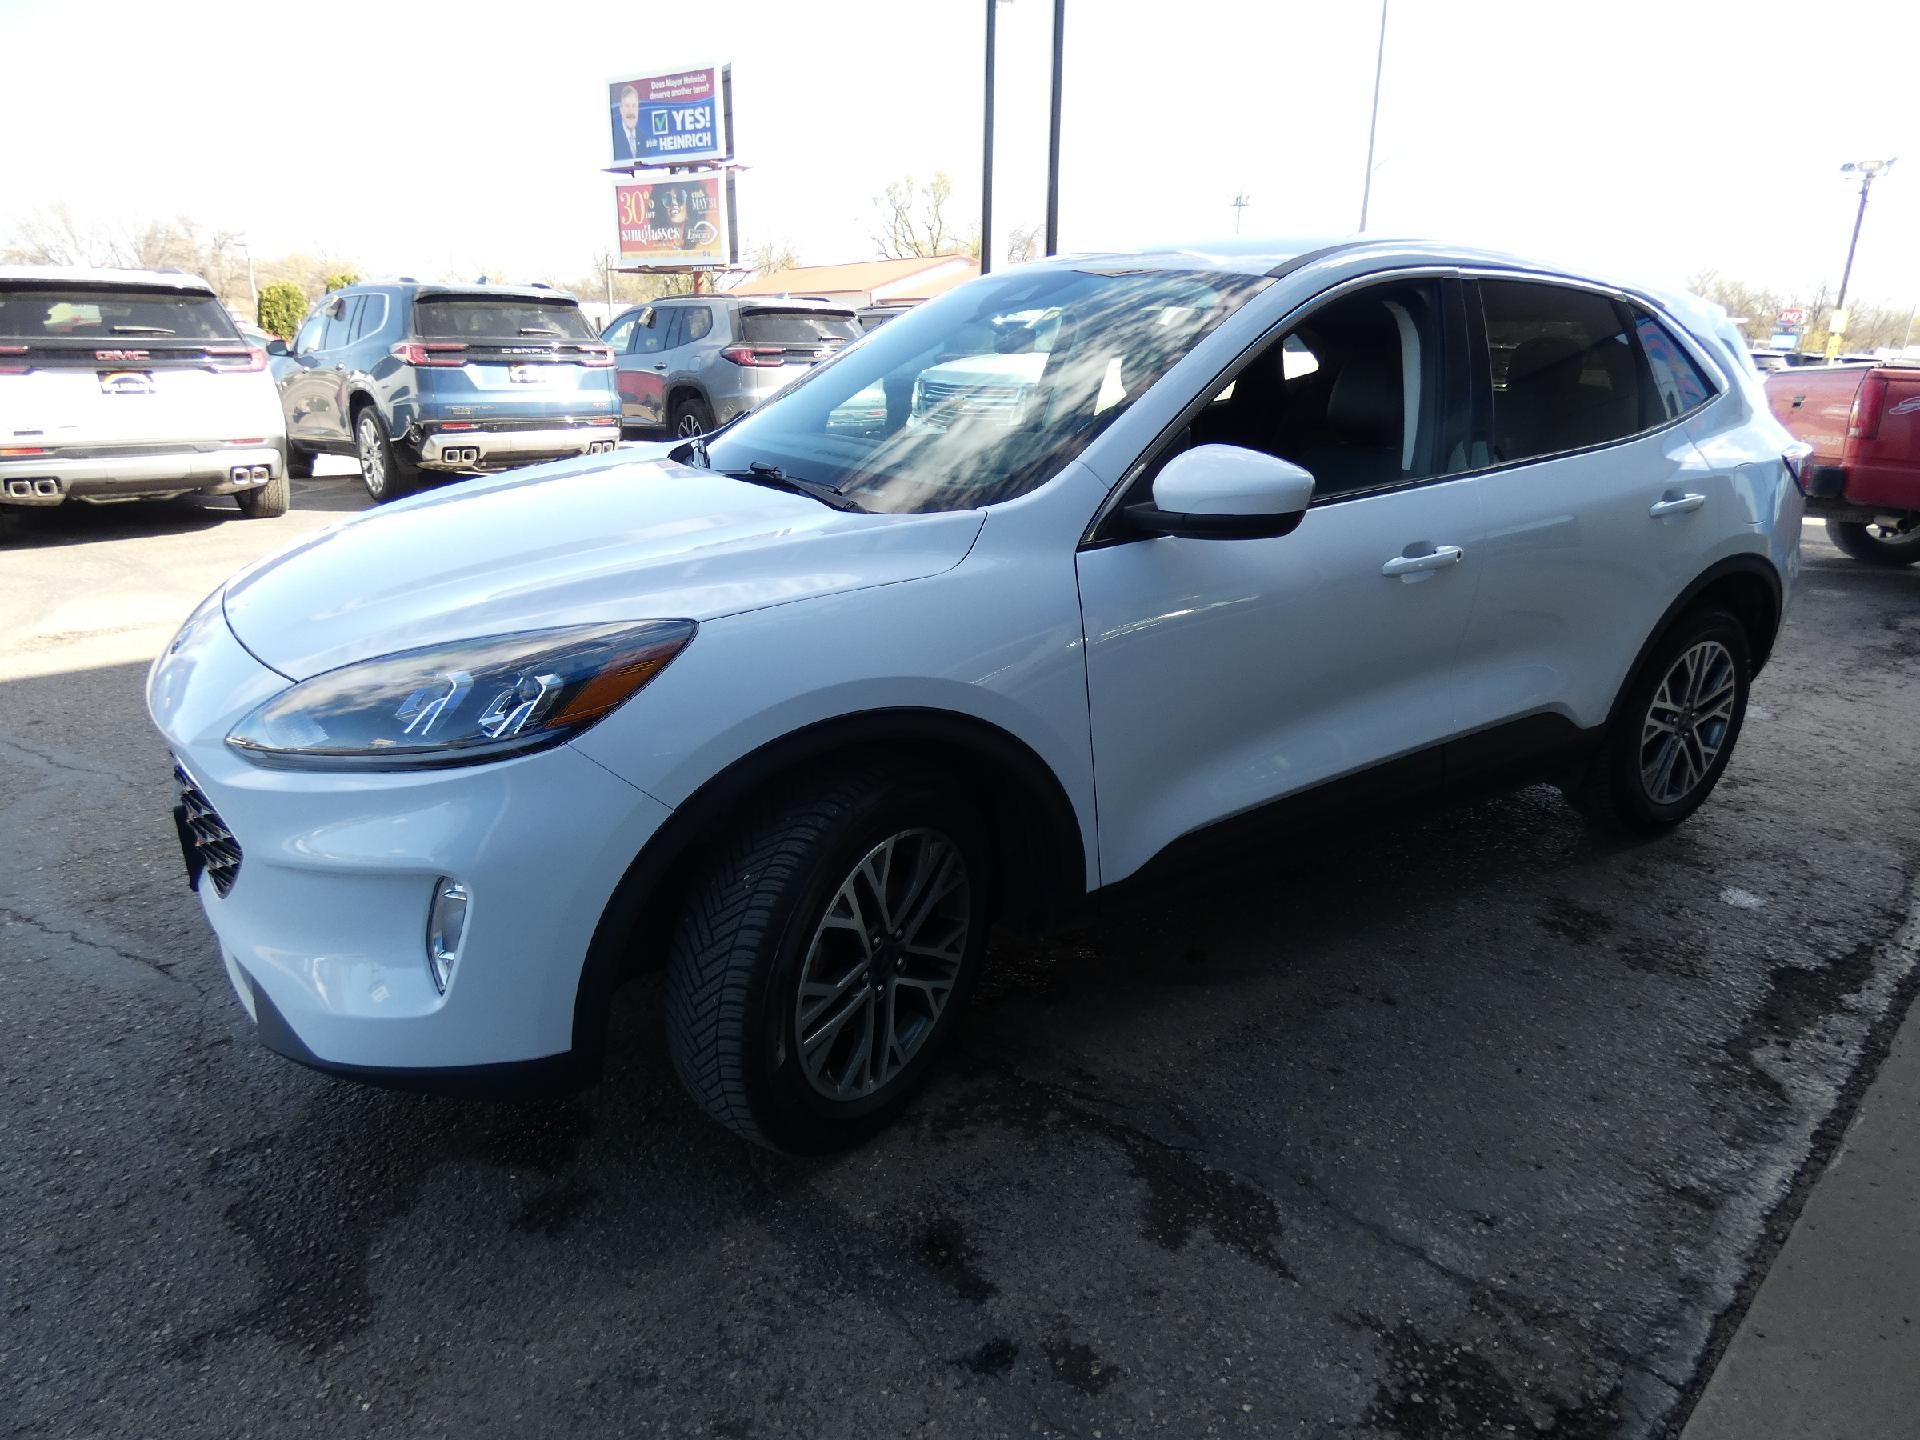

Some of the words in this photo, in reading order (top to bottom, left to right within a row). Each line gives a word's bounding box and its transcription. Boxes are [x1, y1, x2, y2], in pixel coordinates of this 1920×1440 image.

[672, 106, 711, 131] YES!
[659, 132, 712, 151] HEINRICH
[622, 225, 680, 246] sunglasses
[96, 350, 150, 361] GMC
